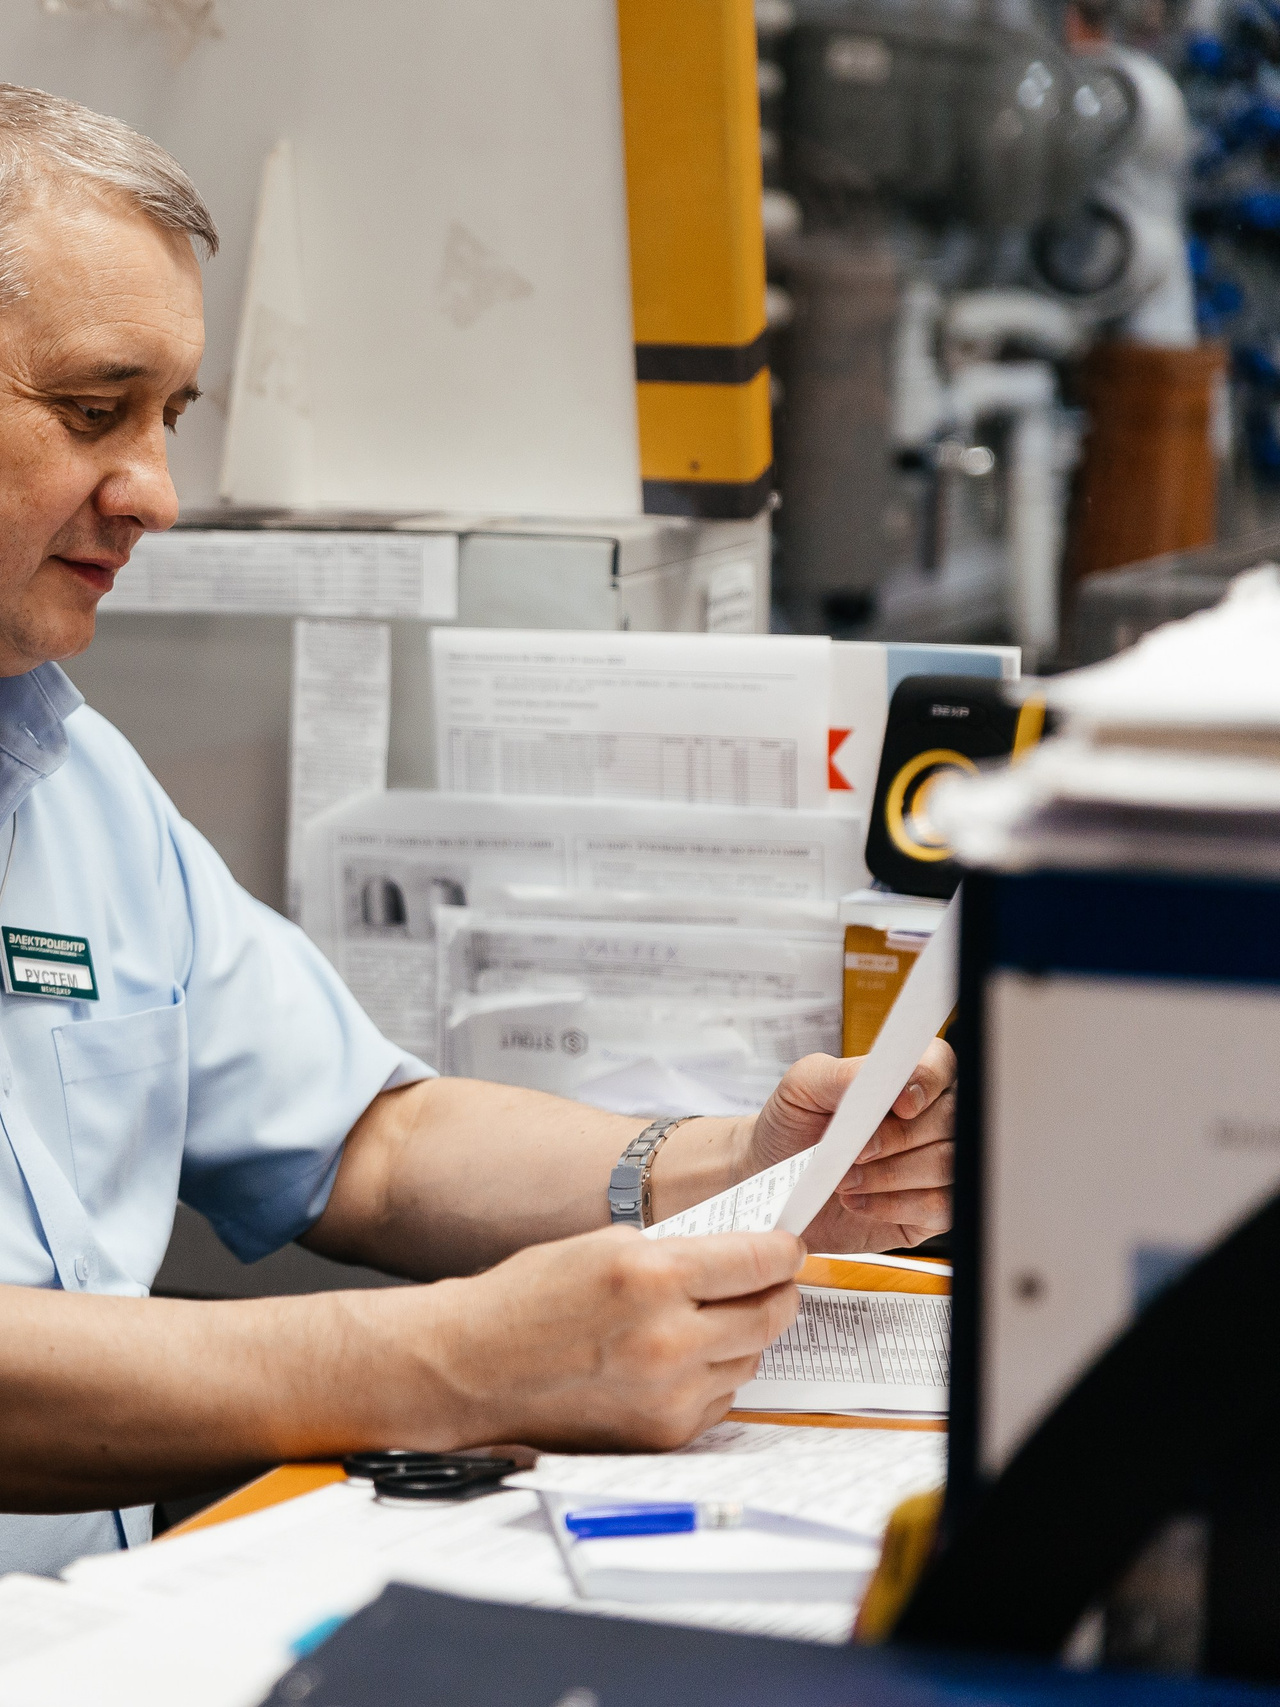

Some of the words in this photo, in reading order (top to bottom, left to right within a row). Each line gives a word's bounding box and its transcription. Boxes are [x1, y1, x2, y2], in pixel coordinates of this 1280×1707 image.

[9, 933, 85, 953] ЭЛЕКТРОЦЕНТР
[24, 968, 79, 988] РУСТЕМ
[40, 985, 72, 996] МЕНЕДЖЕР
